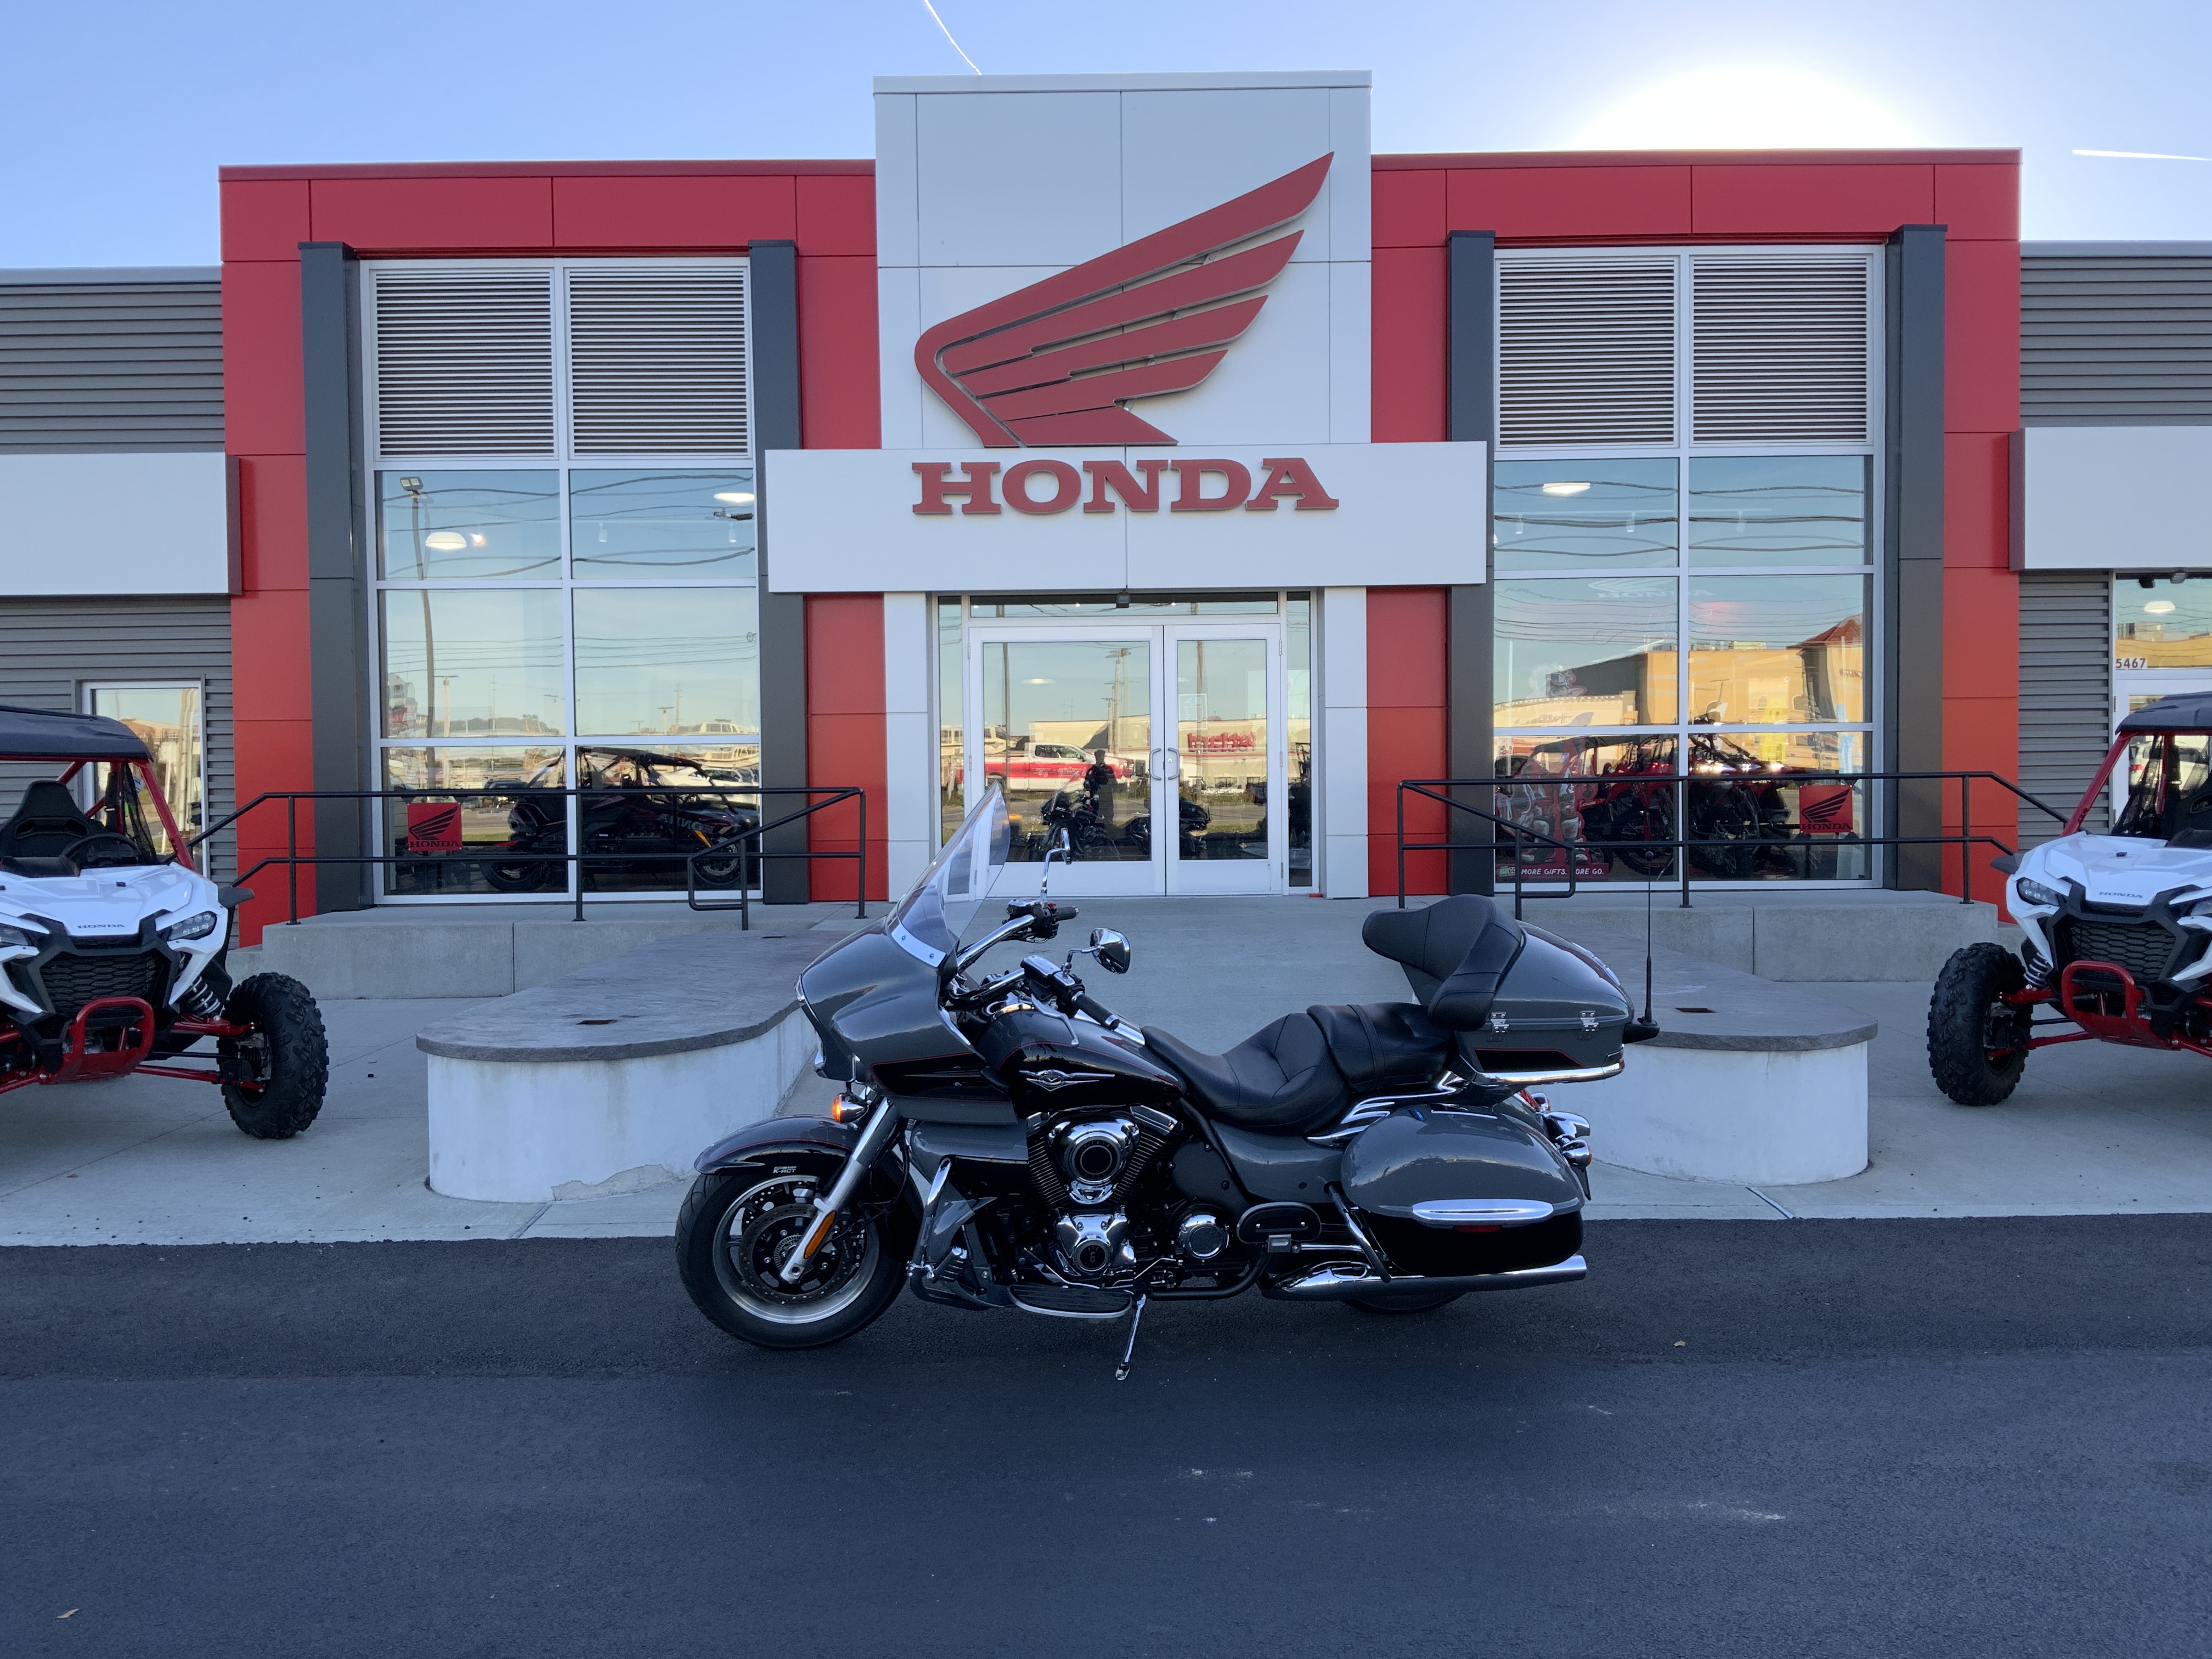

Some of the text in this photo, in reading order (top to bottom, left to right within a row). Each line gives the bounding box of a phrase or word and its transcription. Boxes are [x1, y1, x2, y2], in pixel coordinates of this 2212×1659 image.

[912, 458, 1340, 515] HONDA
[1597, 589, 1718, 599] HONA
[2115, 658, 2146, 668] 5467
